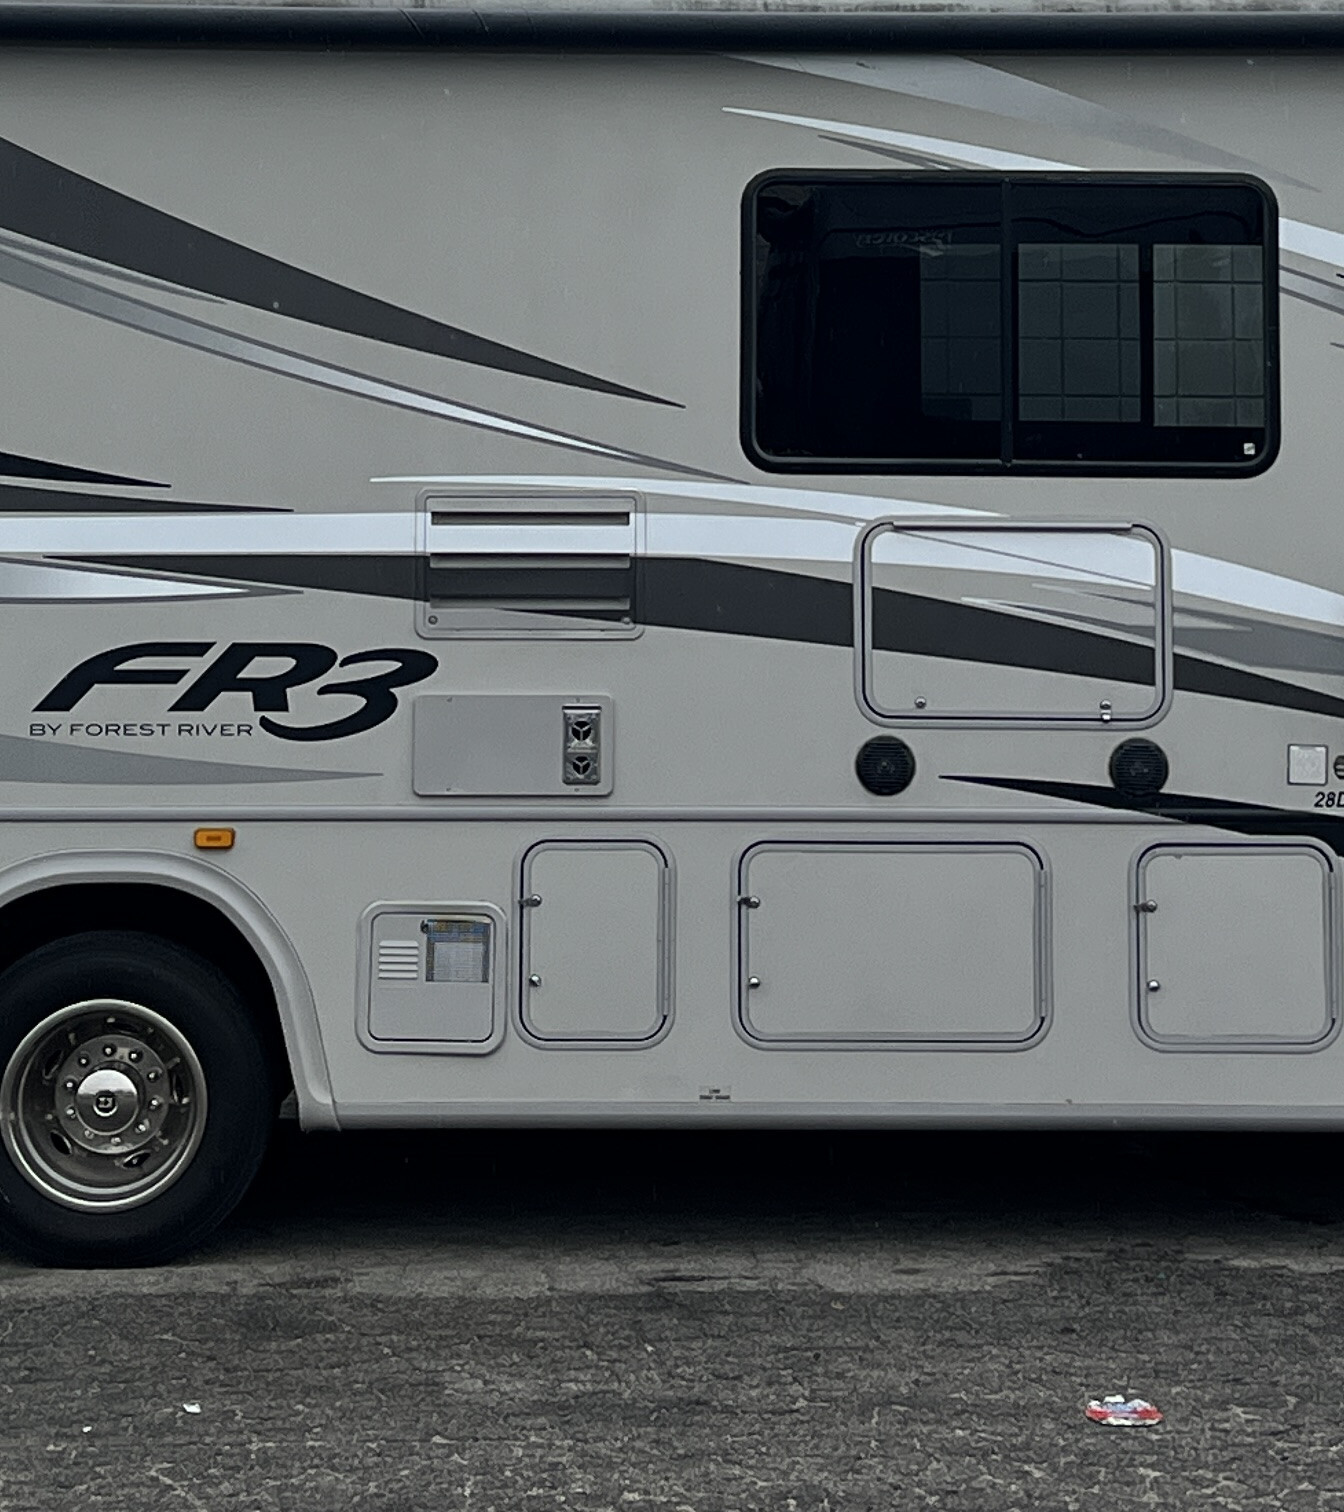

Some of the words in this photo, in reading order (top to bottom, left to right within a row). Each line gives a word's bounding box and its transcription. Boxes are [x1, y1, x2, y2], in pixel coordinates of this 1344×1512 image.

[32, 641, 439, 742] FR3
[29, 723, 62, 737] BY
[69, 723, 172, 737] FOREST
[177, 723, 254, 737] RIVER
